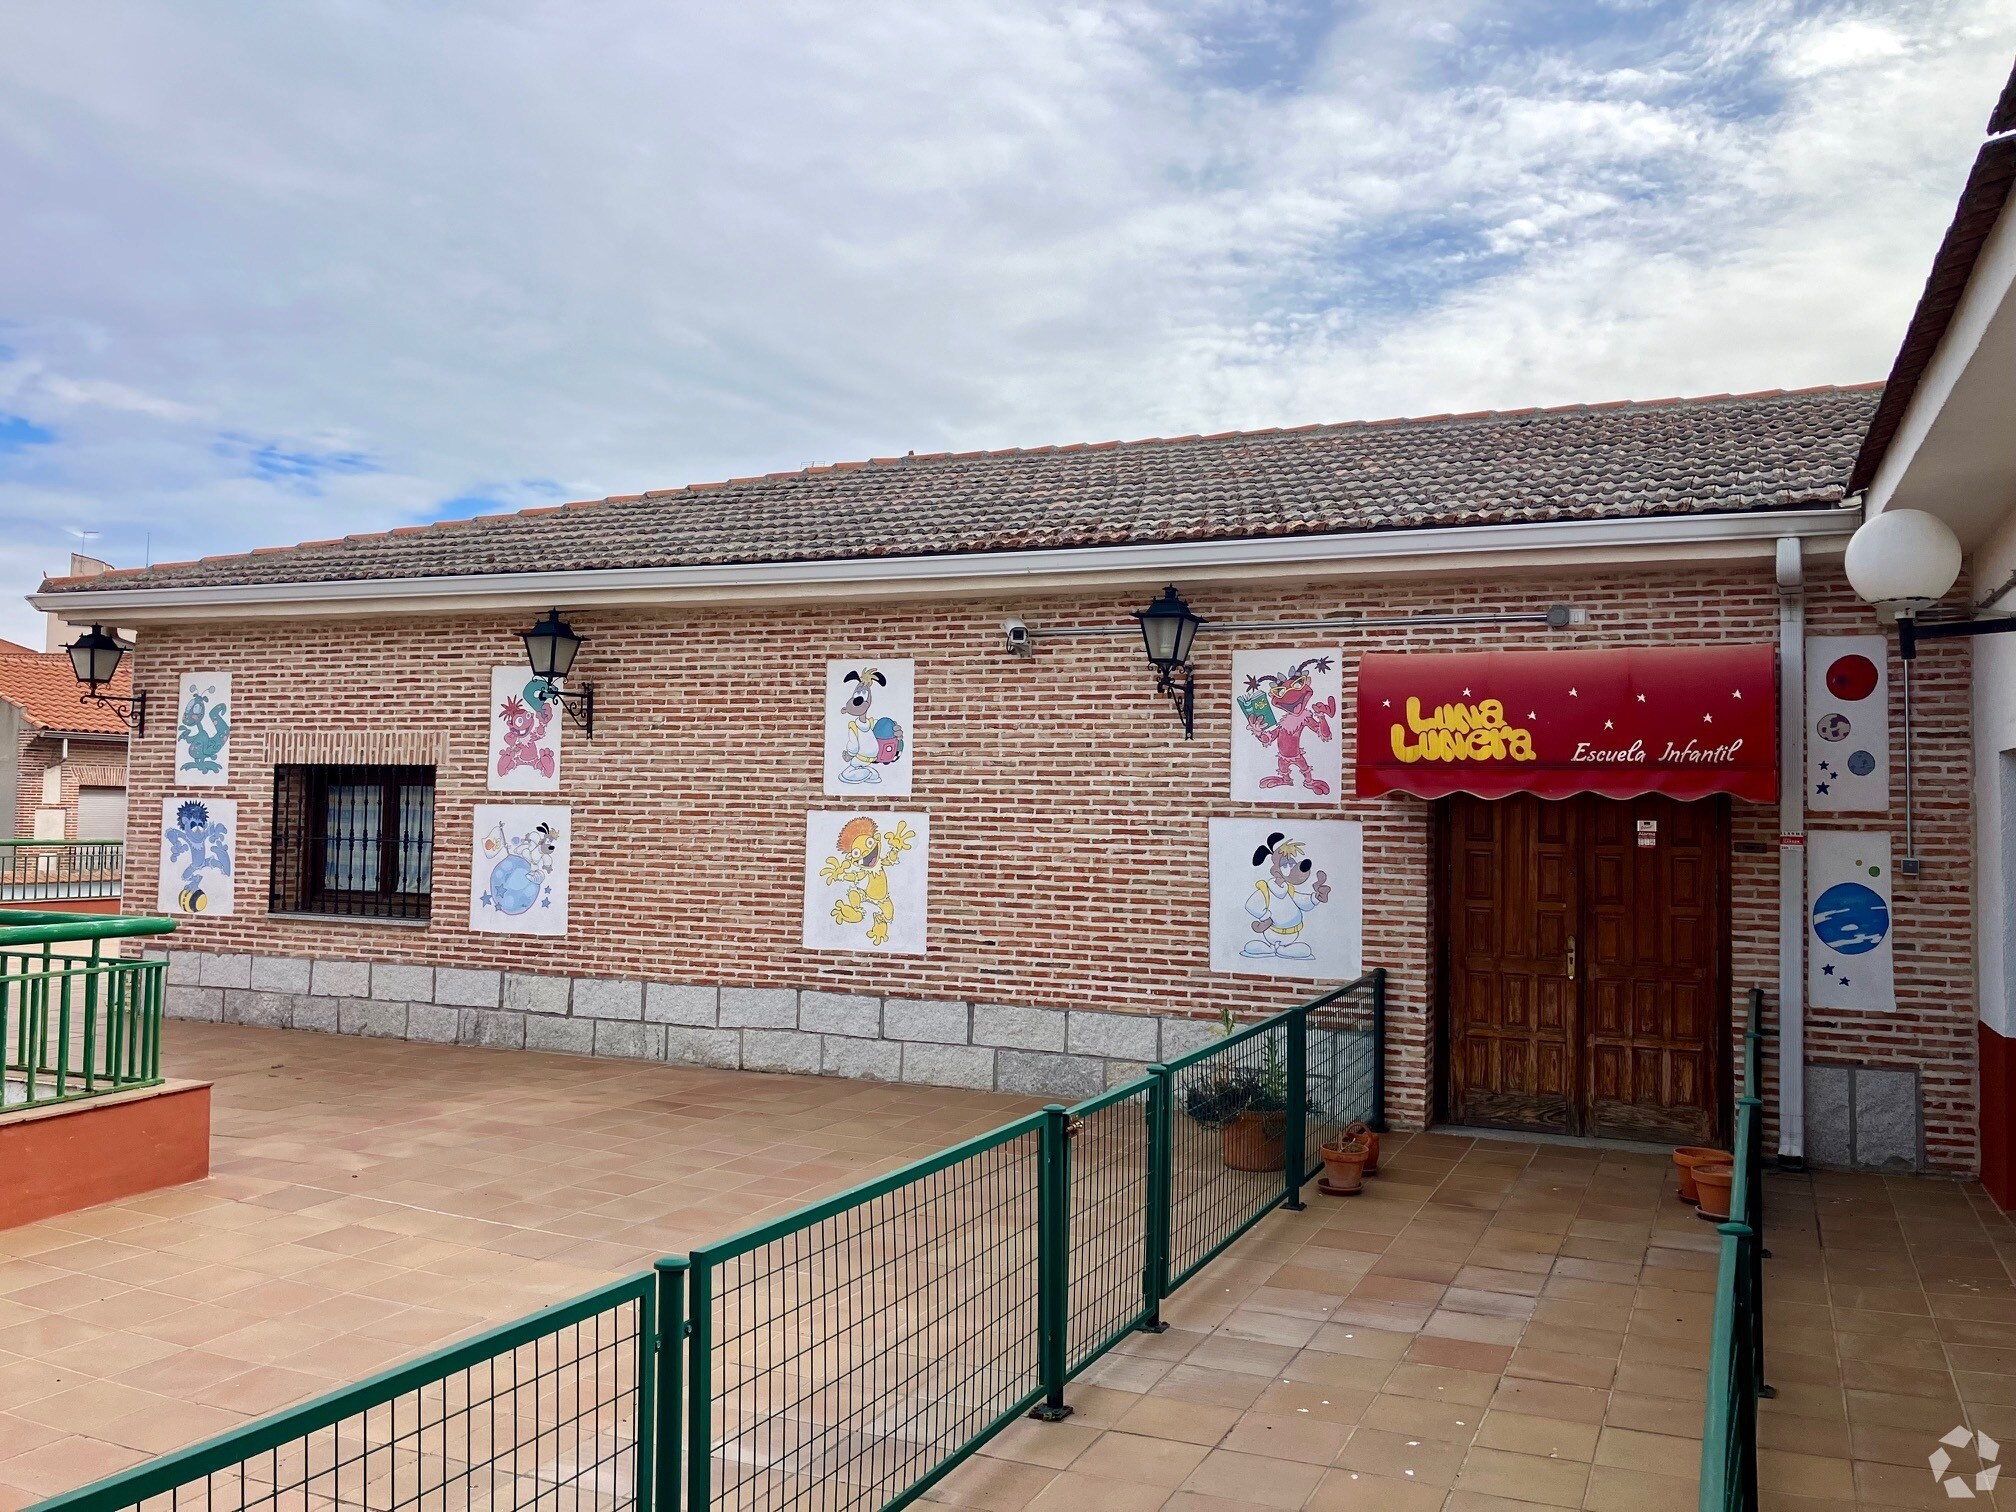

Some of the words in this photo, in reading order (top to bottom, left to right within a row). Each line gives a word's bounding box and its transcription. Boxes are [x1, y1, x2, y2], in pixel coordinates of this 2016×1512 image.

[1254, 698, 1268, 710] ABC
[1406, 696, 1508, 735] Luna
[1391, 723, 1537, 763] Lunera
[1570, 739, 1647, 763] Escuela
[1658, 738, 1743, 763] Infantil
